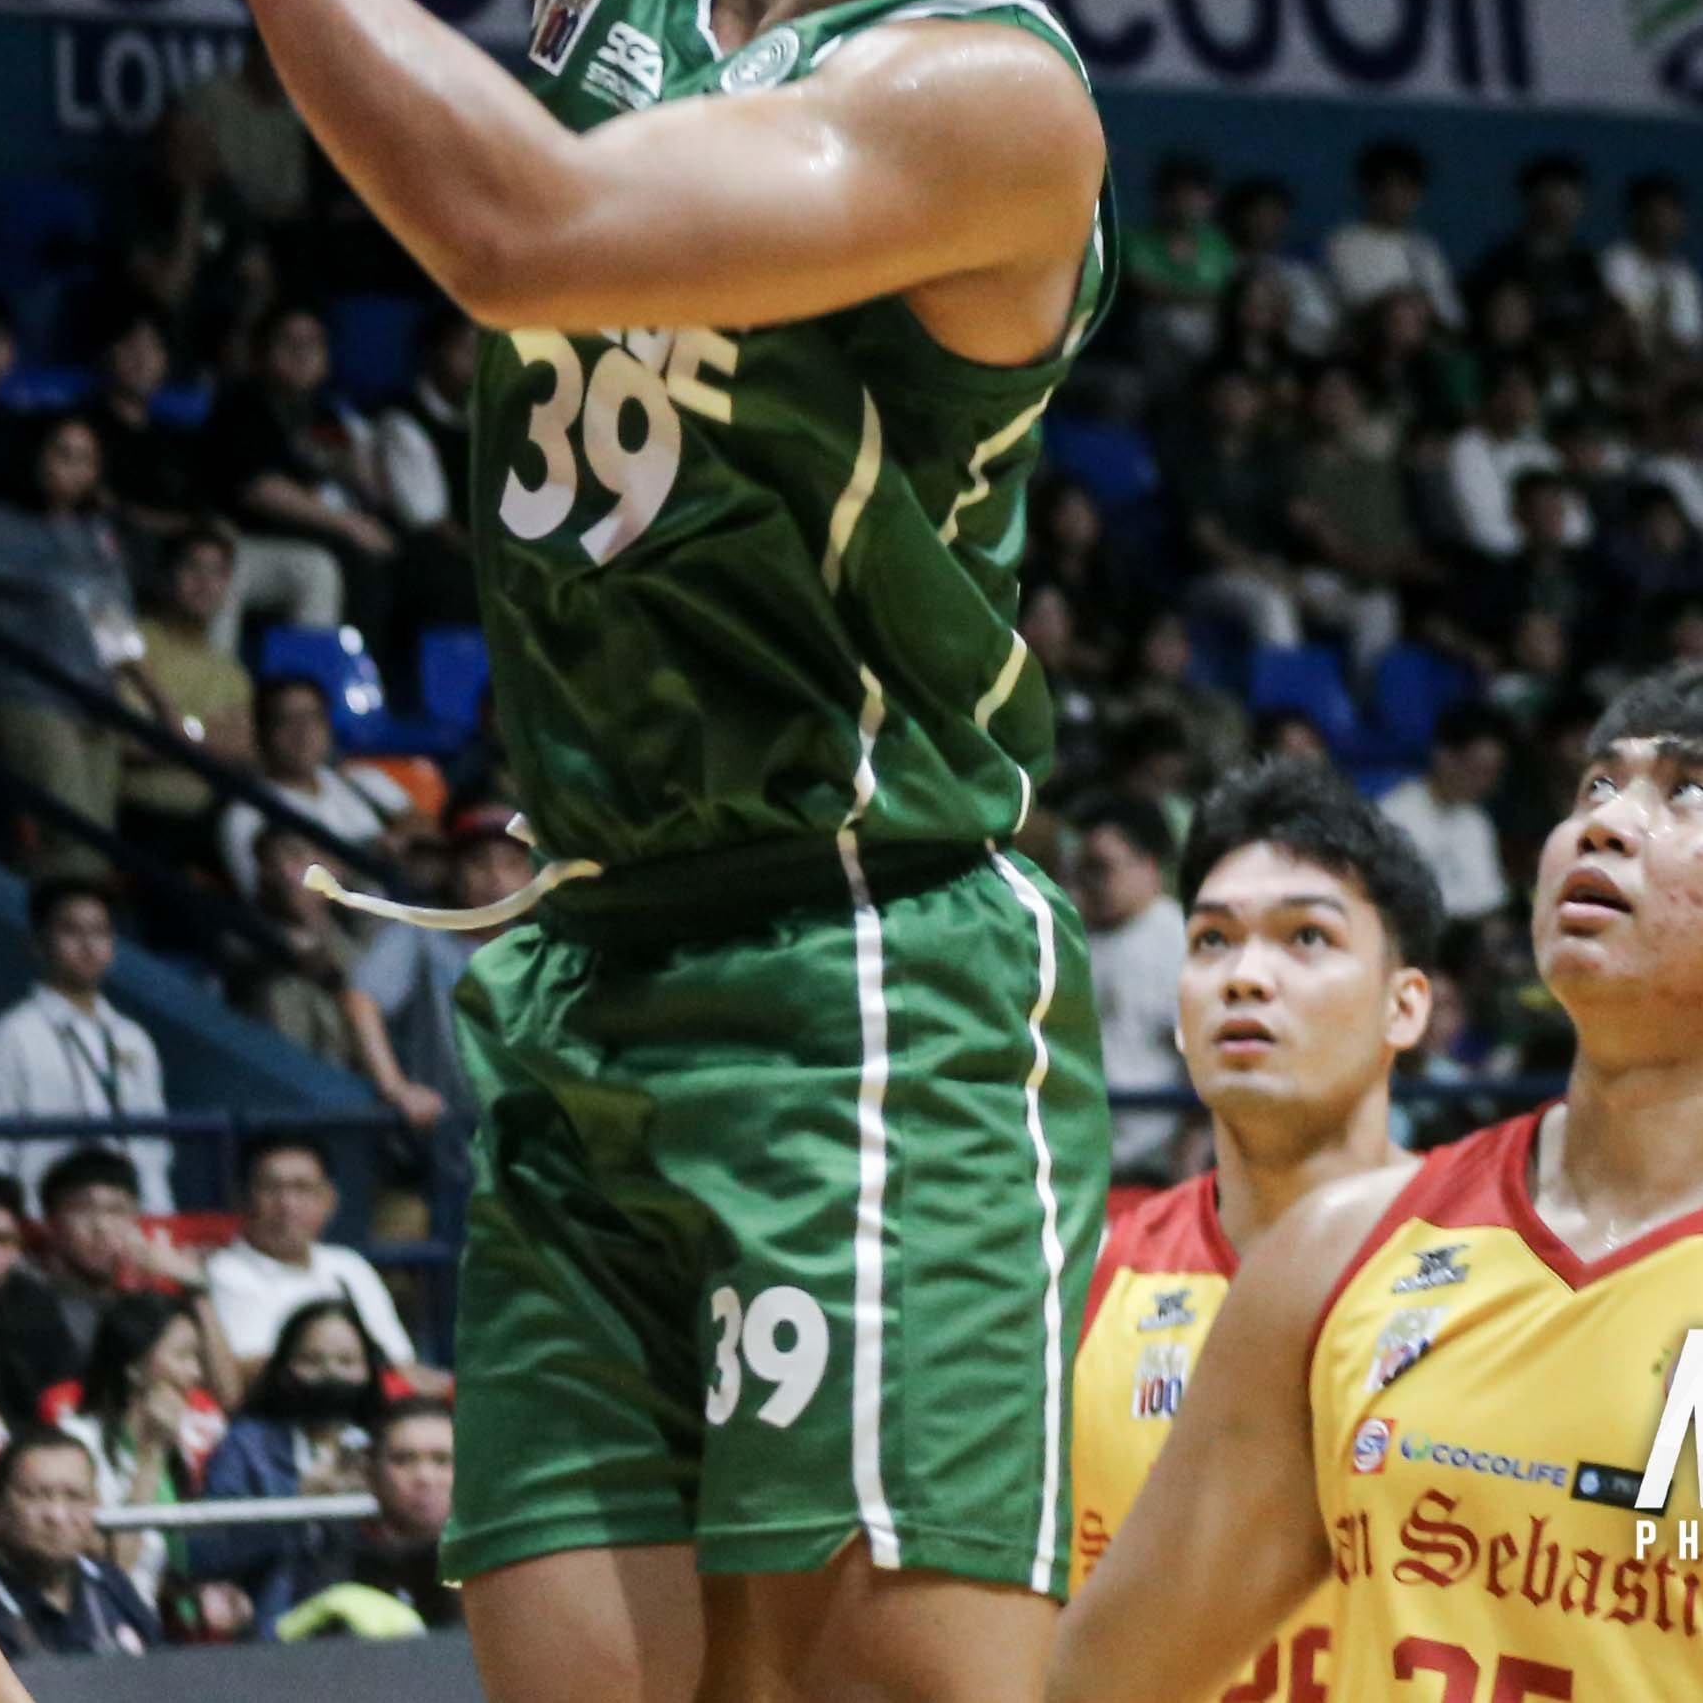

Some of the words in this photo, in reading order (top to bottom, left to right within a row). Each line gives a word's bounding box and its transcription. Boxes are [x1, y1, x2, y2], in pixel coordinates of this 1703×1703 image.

[498, 327, 683, 568] 39
[705, 1285, 830, 1429] 39
[1431, 1443, 1568, 1488] COCOLIFE
